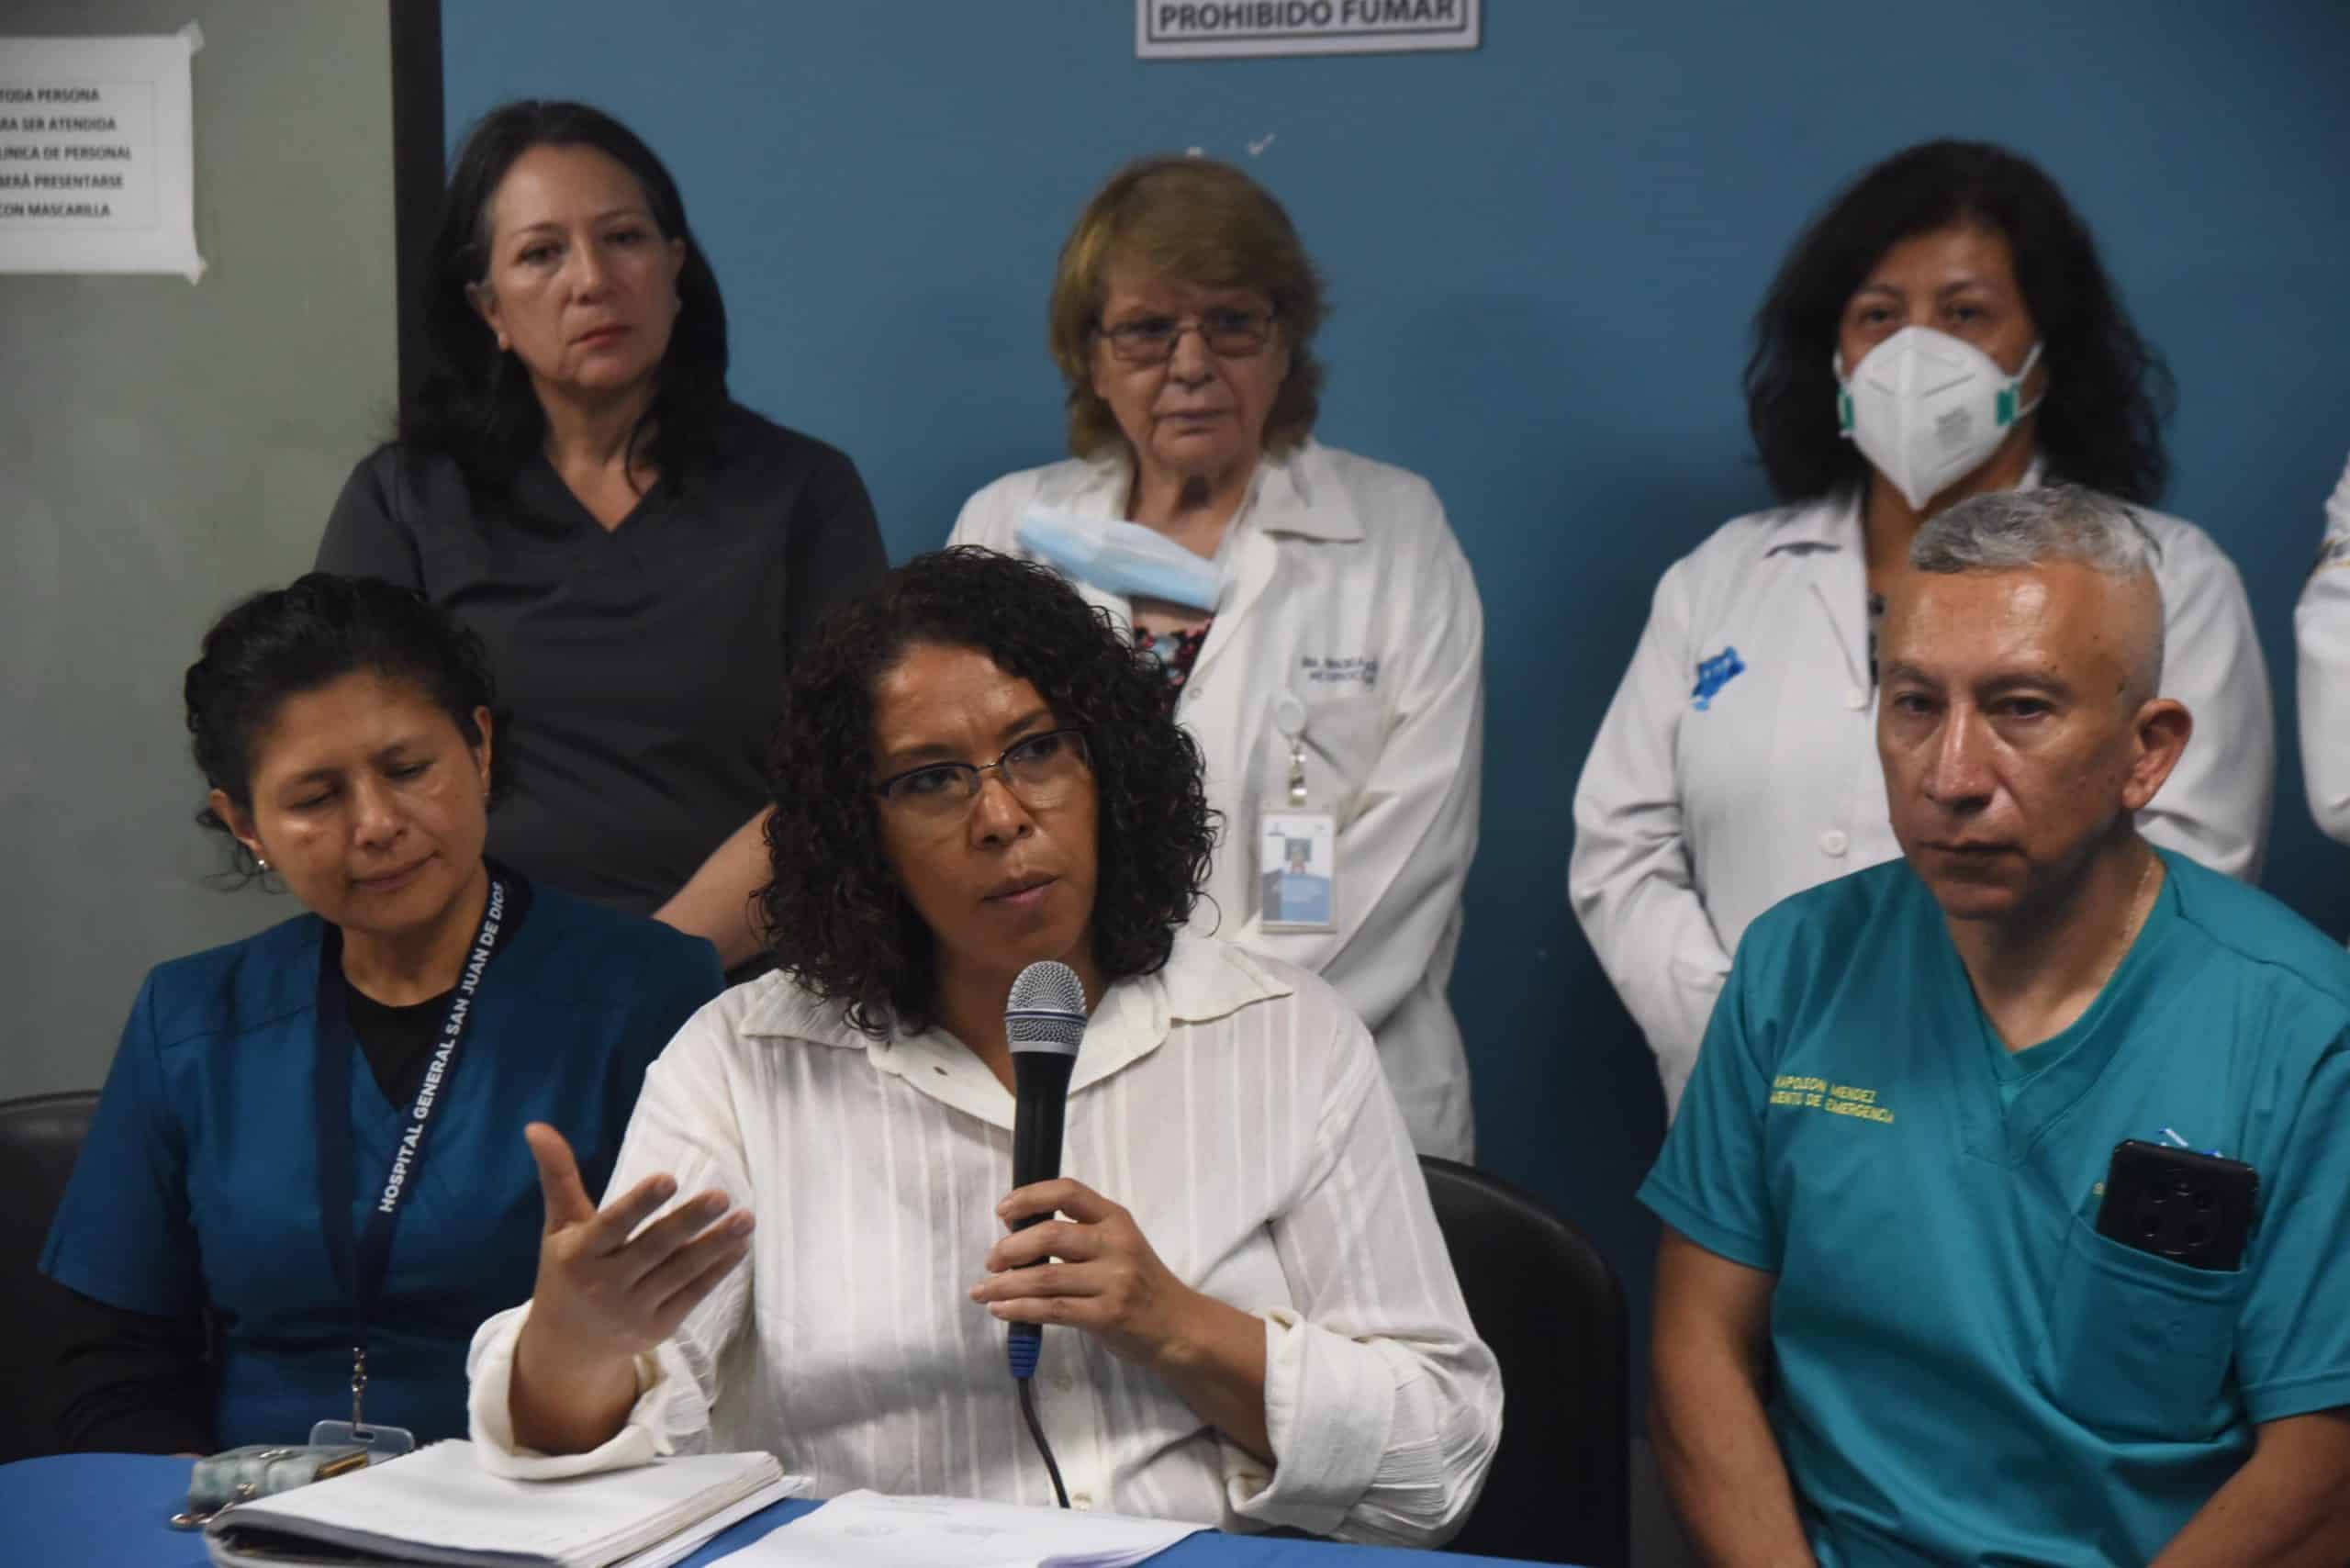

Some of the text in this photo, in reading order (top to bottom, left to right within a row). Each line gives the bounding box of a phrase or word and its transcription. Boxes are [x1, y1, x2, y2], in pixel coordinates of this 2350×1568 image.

[1159, 0, 1454, 30] PROHIBIDO FUMAR
[37, 89, 100, 103] PERSONA
[22, 118, 44, 131] SER
[49, 118, 116, 131] ATENDIDA
[43, 147, 59, 161] DE
[64, 146, 131, 161] PERSONAL
[34, 175, 125, 190] PRESENTARSE
[28, 203, 110, 218] MASCARILLA
[378, 1124, 424, 1213] HOSPITAL
[413, 1038, 456, 1120] GENERAL
[445, 998, 471, 1036] SAN
[462, 948, 490, 994] JUAN
[480, 923, 499, 947] DE
[1805, 1092, 1822, 1107] DE
[1824, 1098, 1895, 1124] EMERGENCIA
